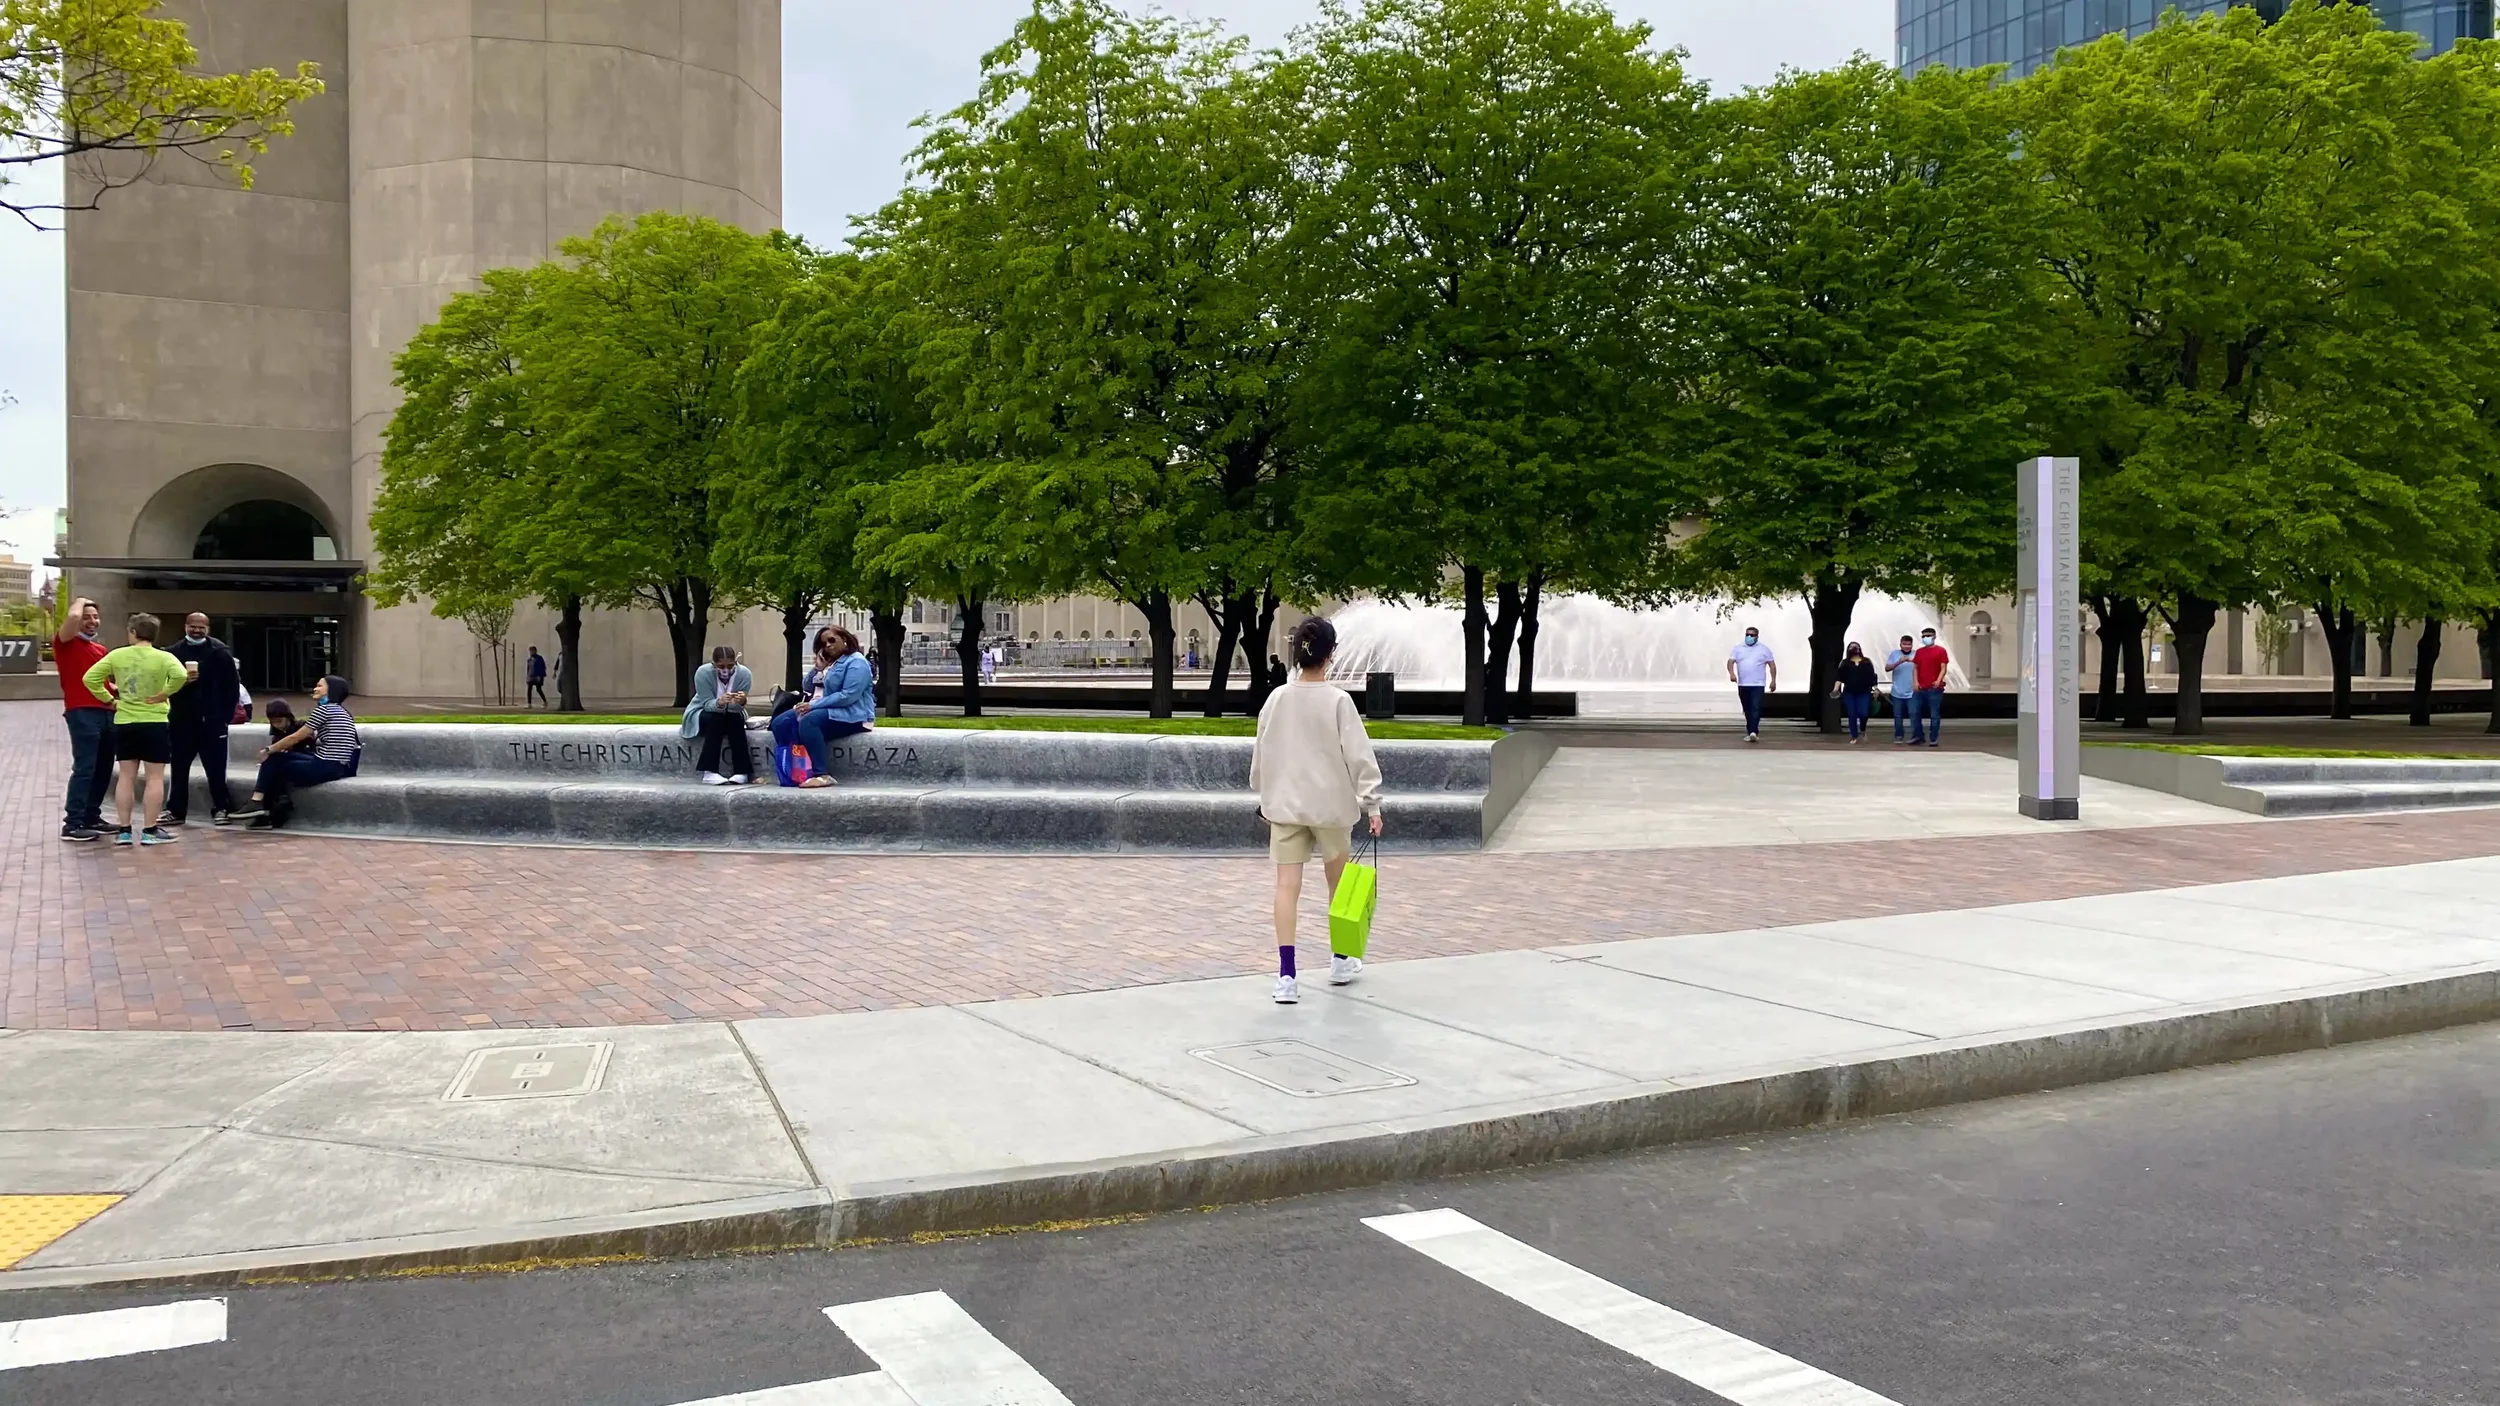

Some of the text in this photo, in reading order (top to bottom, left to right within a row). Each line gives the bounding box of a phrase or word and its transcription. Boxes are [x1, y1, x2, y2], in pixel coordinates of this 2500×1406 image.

[2059, 466, 2071, 705] THE CHRISTIAN SCIENCE PLAZA
[509, 742, 919, 767] THE CHRISTIAN PLAZA
